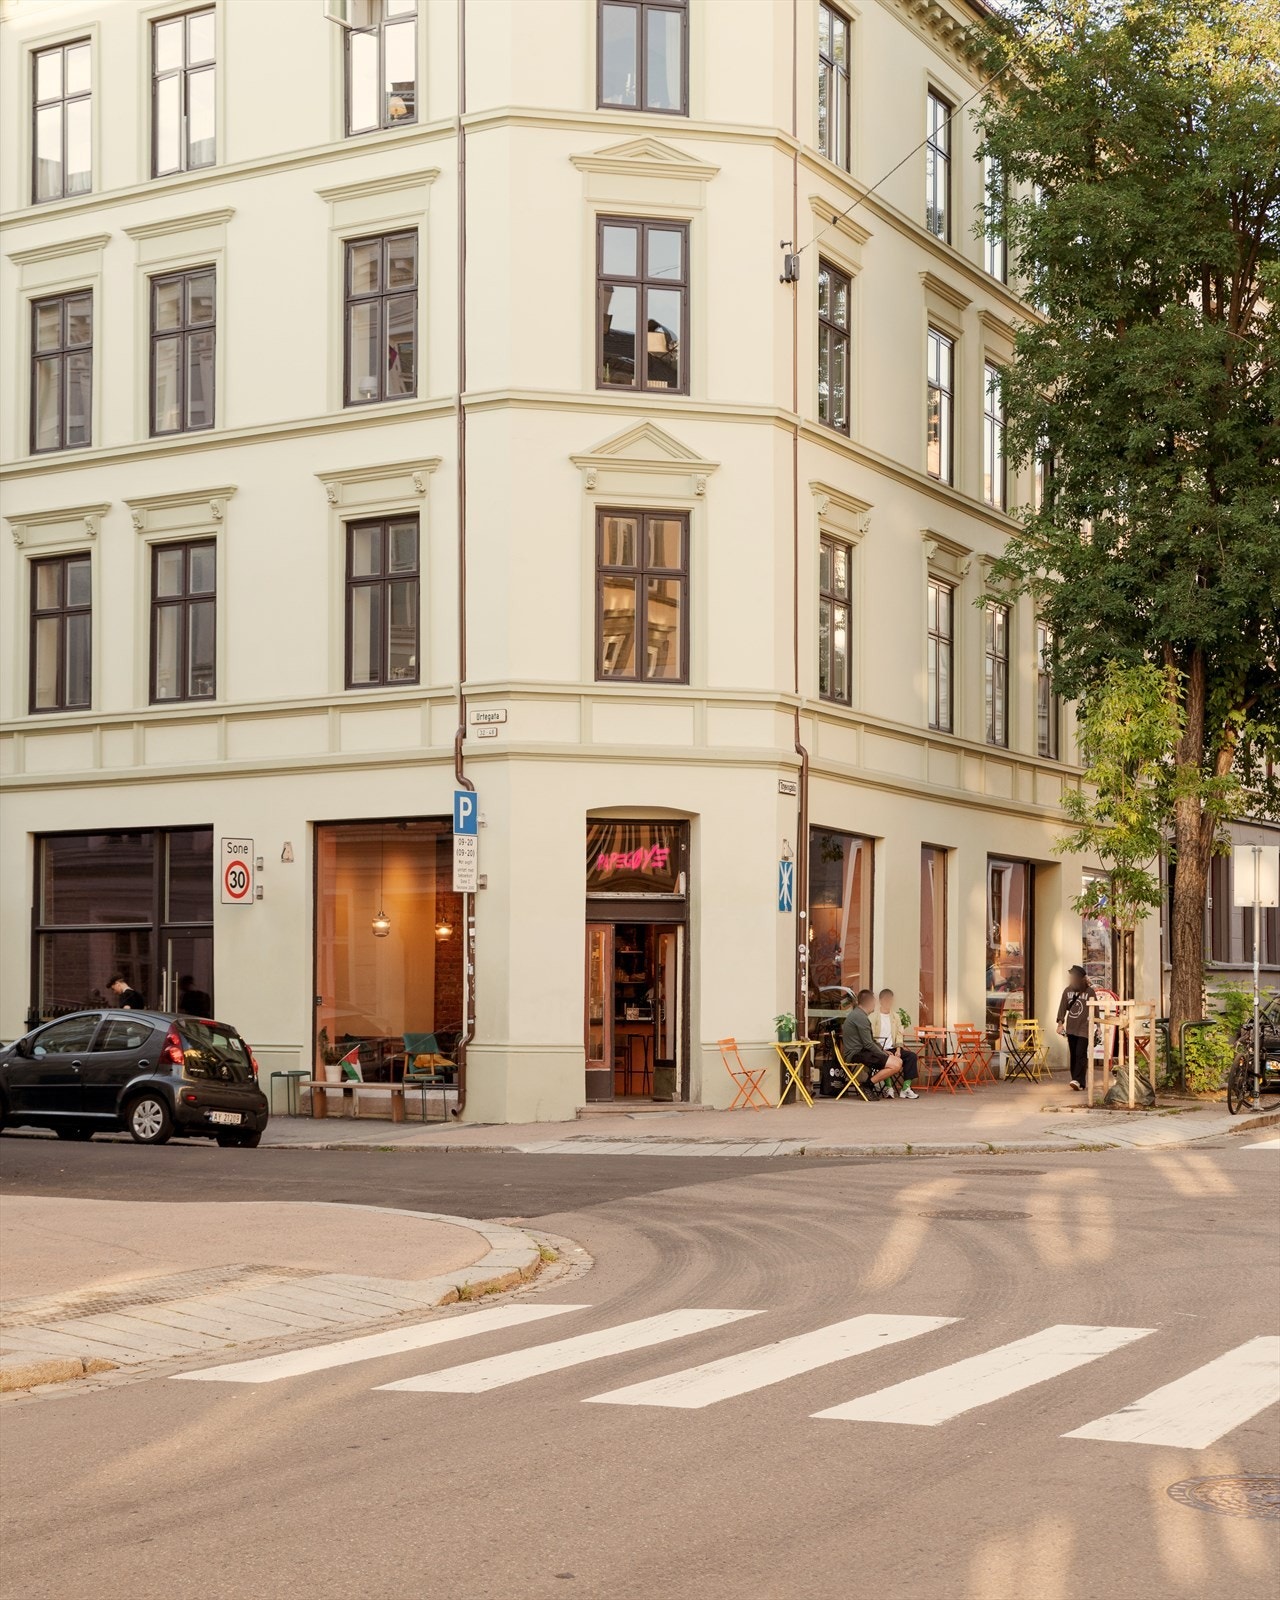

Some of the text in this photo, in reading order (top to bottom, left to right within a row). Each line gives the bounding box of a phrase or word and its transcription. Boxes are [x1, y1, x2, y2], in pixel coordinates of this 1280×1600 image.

[476, 713, 500, 722] Urtegata
[459, 796, 472, 829] P
[226, 841, 249, 854] Sone
[457, 838, 474, 846] 09-20
[455, 848, 476, 857] (09-20)
[229, 870, 246, 889] 30
